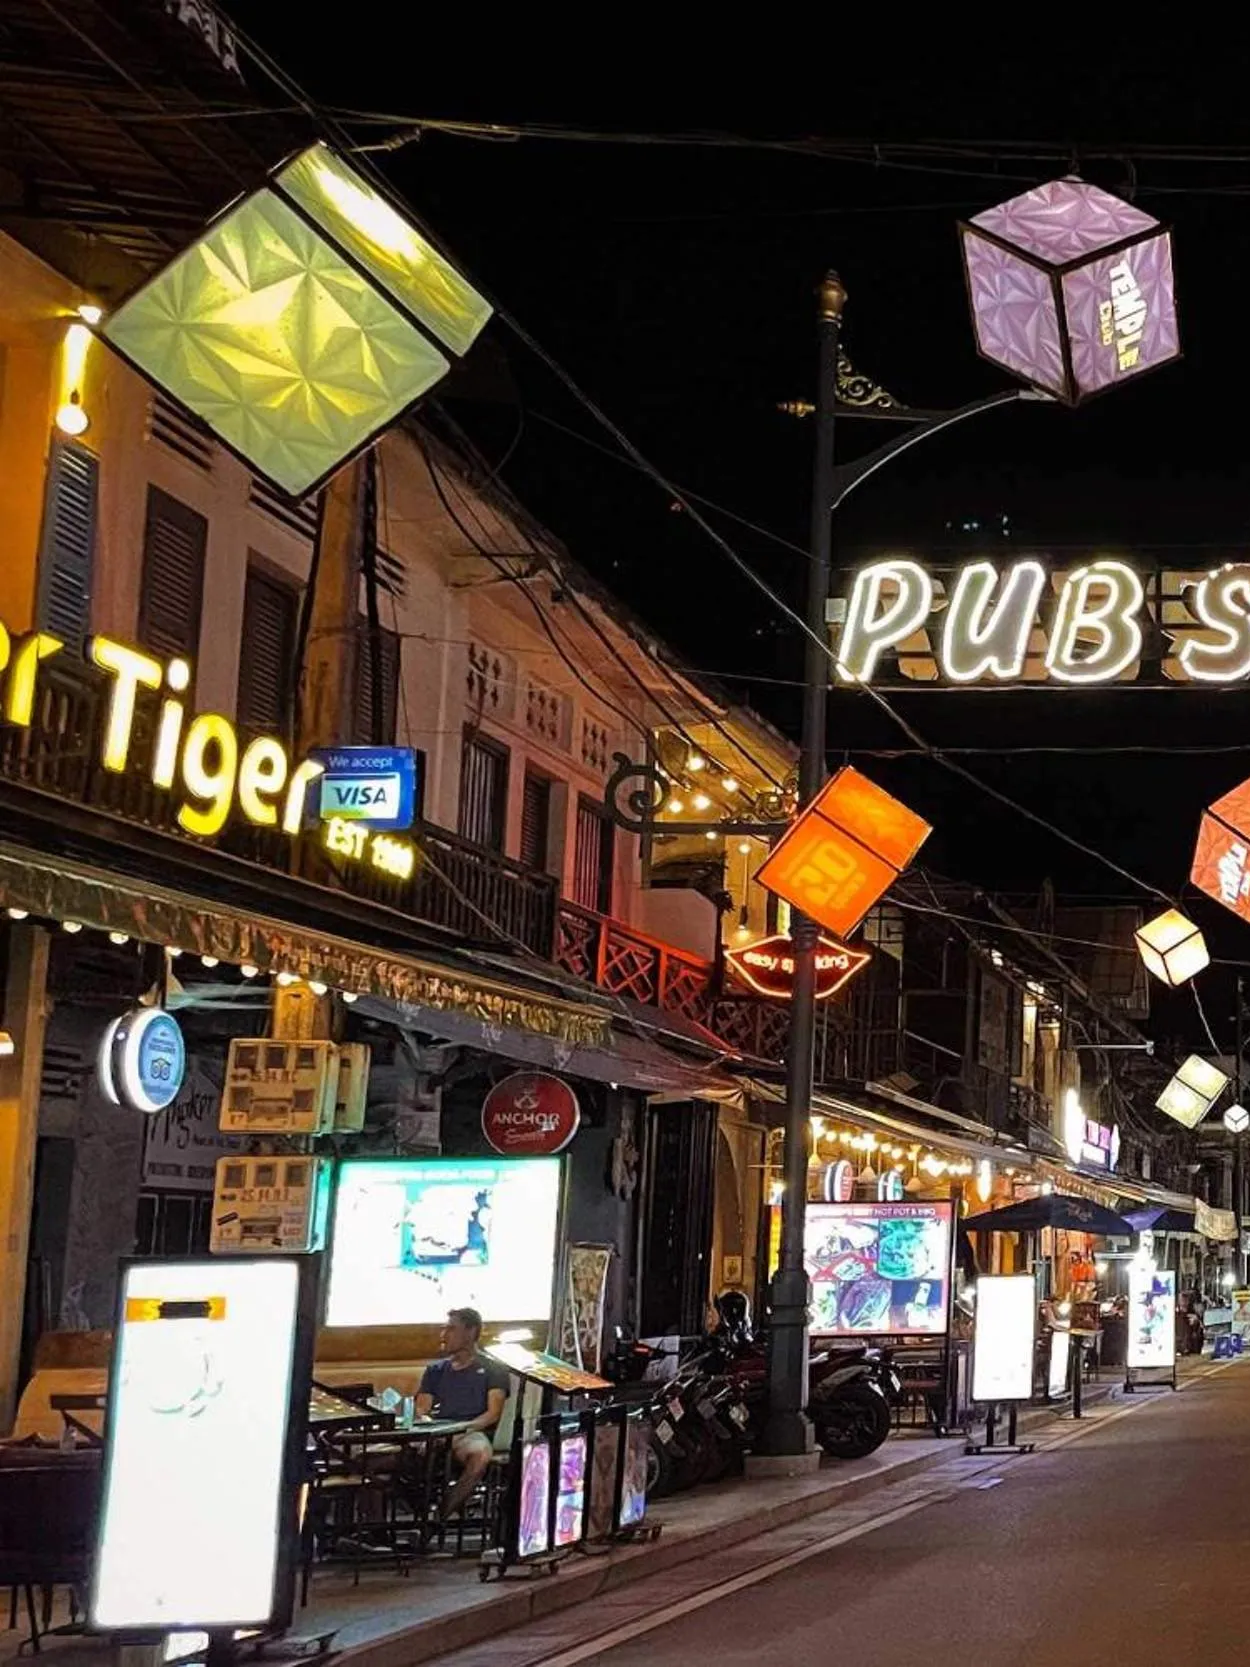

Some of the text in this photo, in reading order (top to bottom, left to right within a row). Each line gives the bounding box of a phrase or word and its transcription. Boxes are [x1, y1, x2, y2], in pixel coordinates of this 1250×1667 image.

[1108, 260, 1148, 372] TEMPLE
[836, 560, 1143, 683] PUB
[92, 634, 326, 836] Tiger
[328, 755, 393, 770] We accept
[334, 786, 387, 805] VISA
[491, 1112, 561, 1126] ANCHOR
